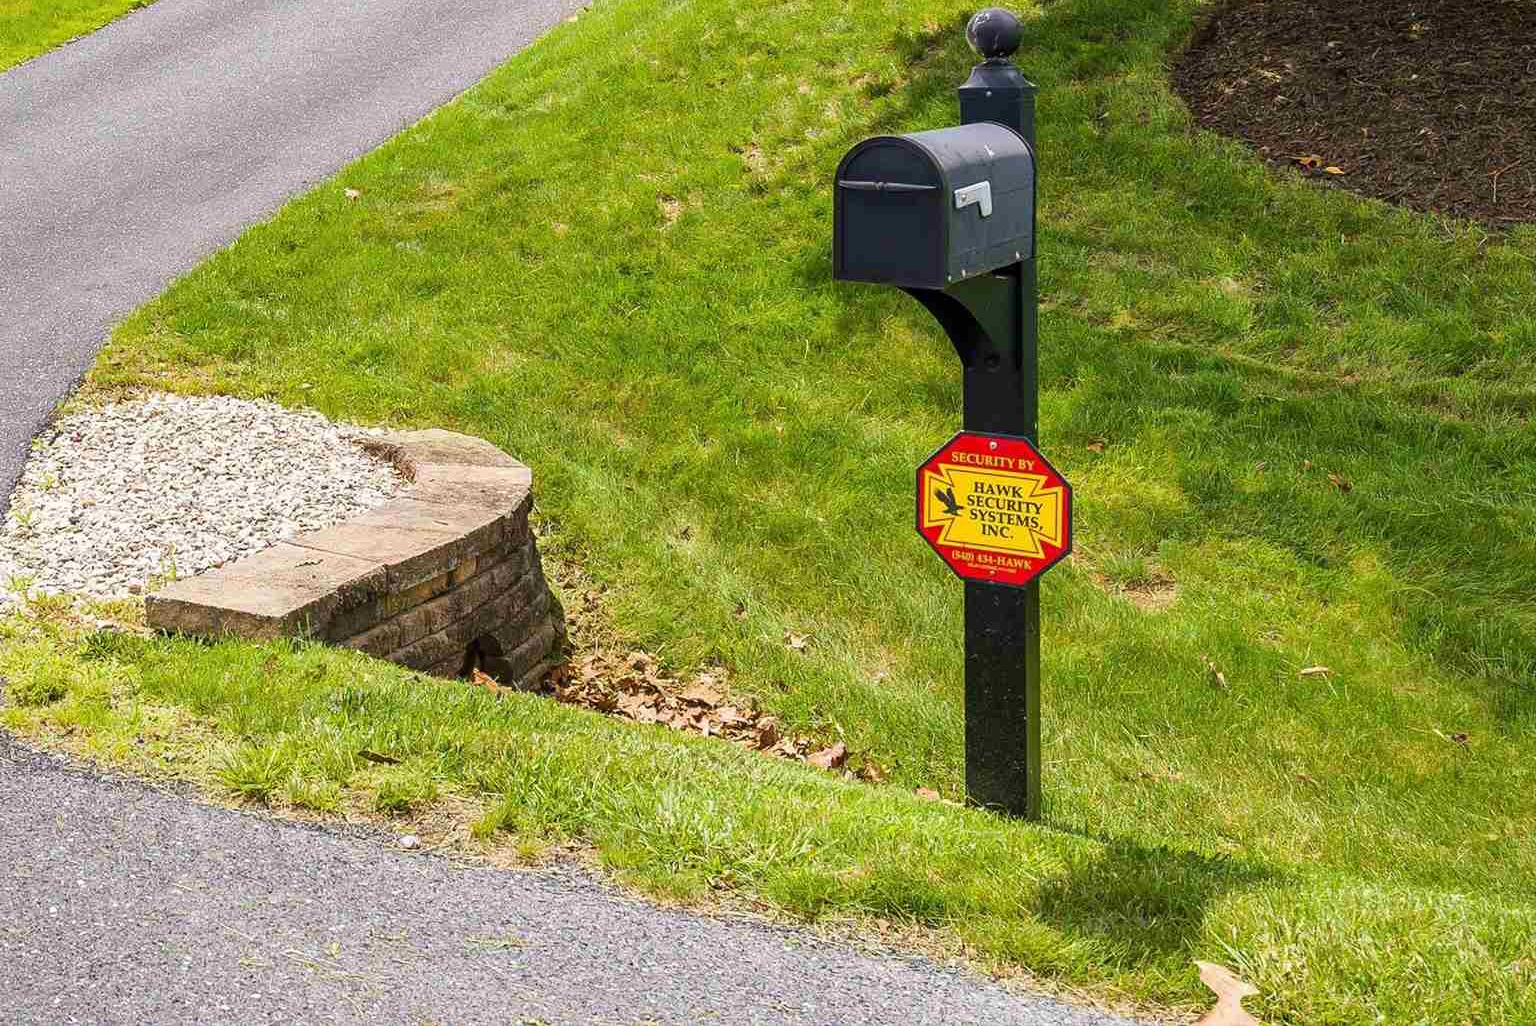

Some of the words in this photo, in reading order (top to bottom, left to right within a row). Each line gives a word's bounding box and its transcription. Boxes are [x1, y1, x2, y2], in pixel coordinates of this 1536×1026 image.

[952, 452, 1016, 468] SECURITY
[1019, 459, 1035, 471] BY
[974, 482, 1023, 498] HAWK
[967, 495, 1043, 515] SECURITY
[970, 509, 1044, 531] SYSTEMS,
[982, 524, 1014, 539] INC.
[952, 549, 975, 562] (540)
